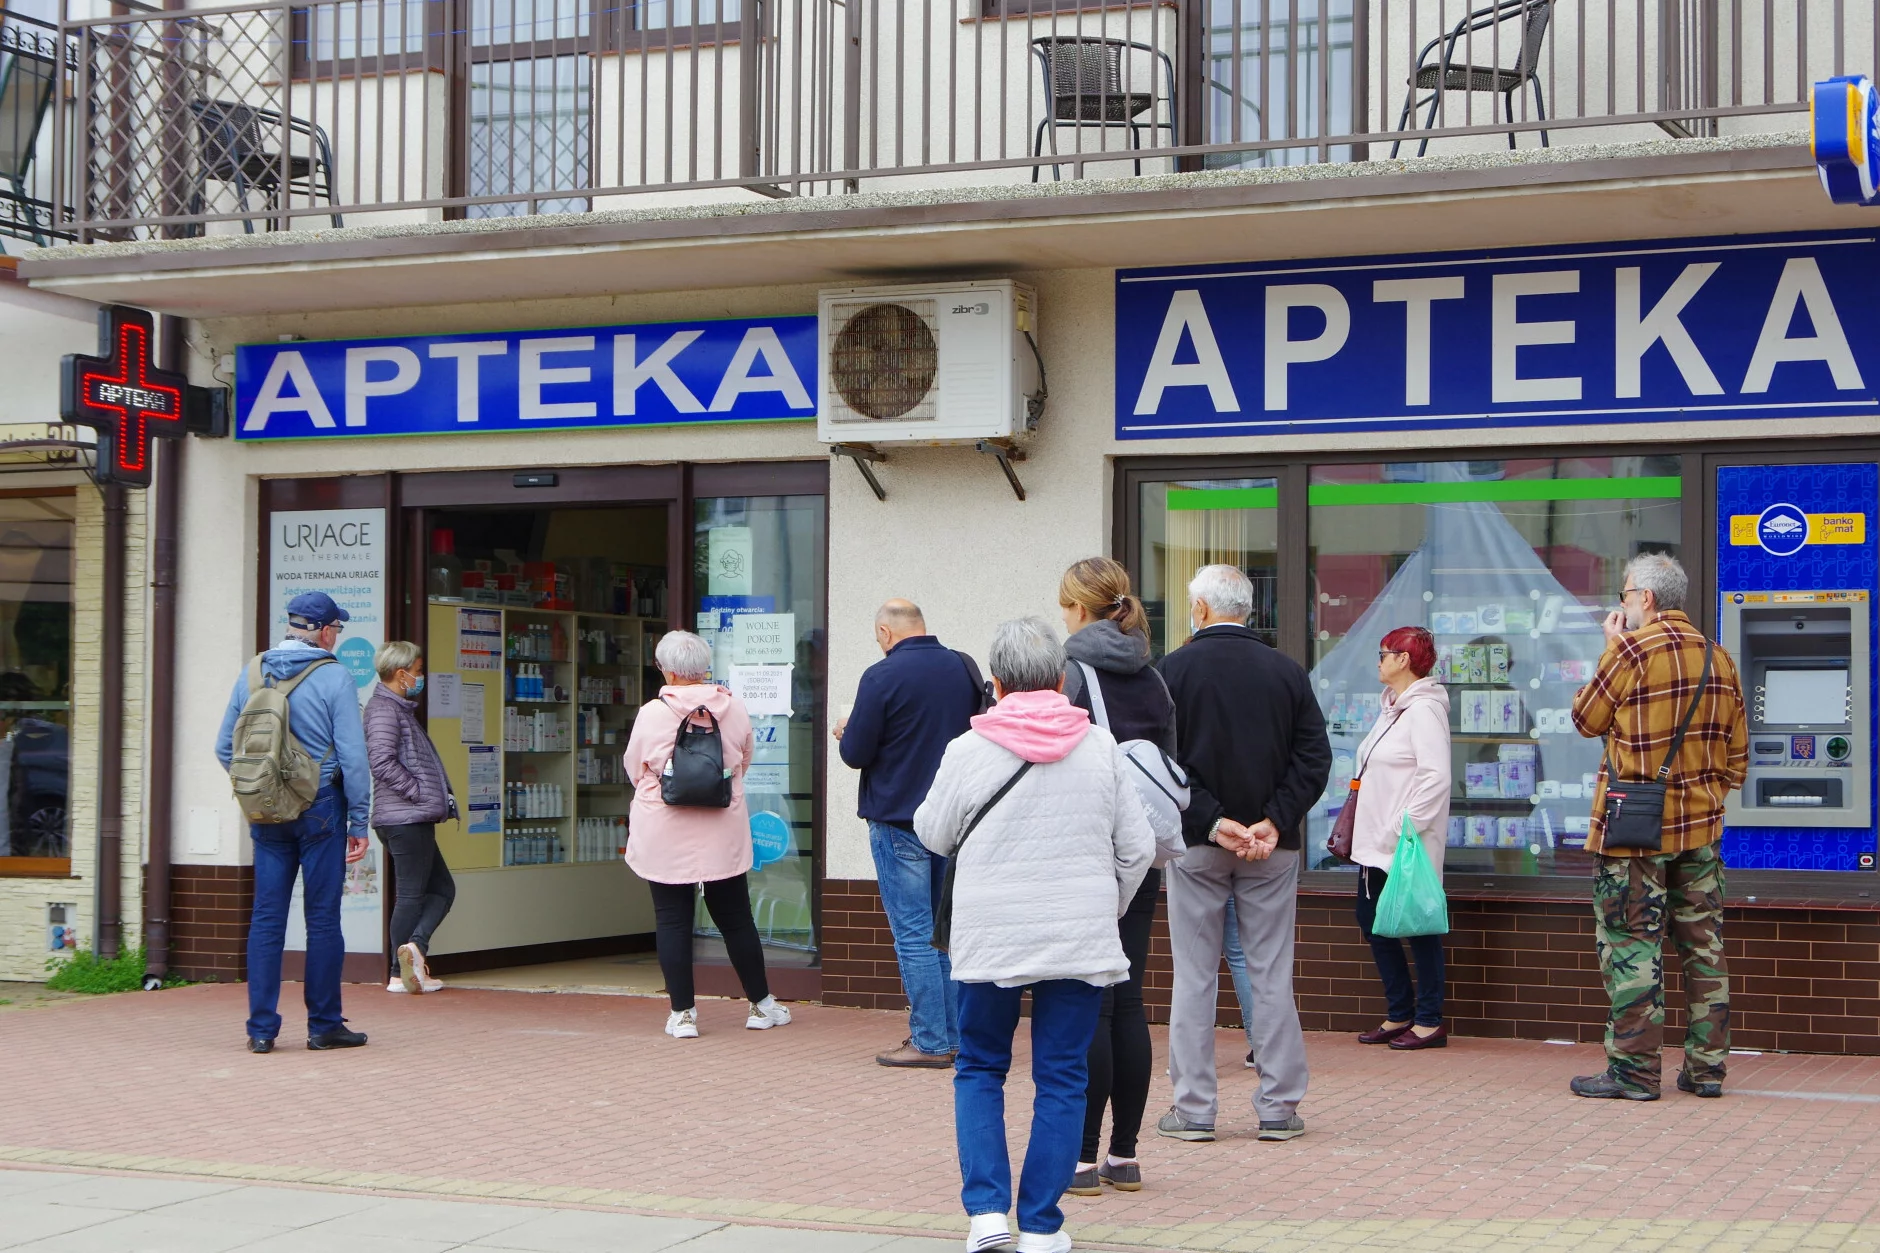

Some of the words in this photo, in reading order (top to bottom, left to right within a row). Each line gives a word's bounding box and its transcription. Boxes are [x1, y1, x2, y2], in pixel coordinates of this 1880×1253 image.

[1133, 256, 1866, 416] APTEKA
[243, 326, 815, 431] APTEKA
[99, 383, 166, 411] APTEKA
[1823, 517, 1854, 526] banko
[1834, 525, 1854, 533] mat
[283, 522, 371, 553] URIAGE
[283, 554, 304, 562] EAU
[312, 553, 371, 561] THERMALE
[276, 572, 302, 581] WODA
[304, 571, 347, 580] TERMALNA
[349, 570, 379, 579] URIAGE
[710, 607, 735, 615] Godziny
[746, 621, 780, 630] WOLNE
[747, 634, 781, 644] POKOJE
